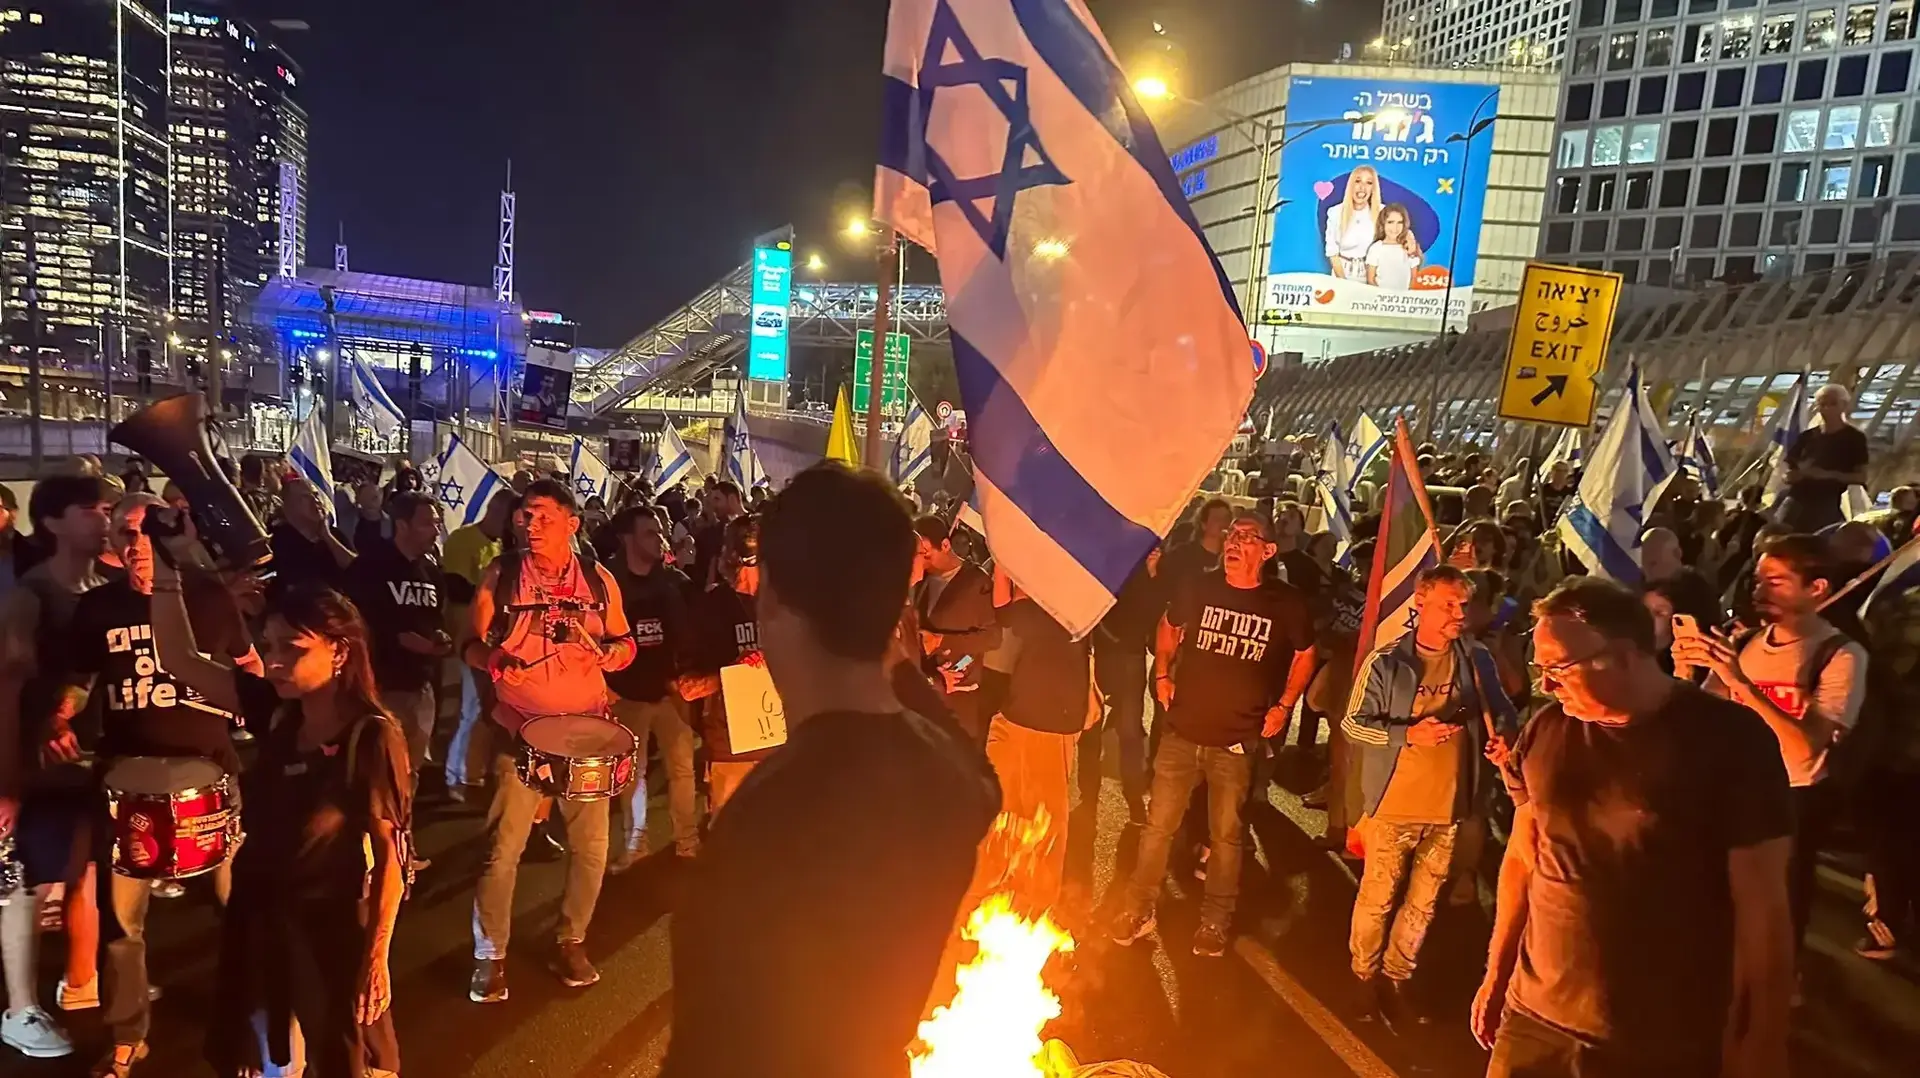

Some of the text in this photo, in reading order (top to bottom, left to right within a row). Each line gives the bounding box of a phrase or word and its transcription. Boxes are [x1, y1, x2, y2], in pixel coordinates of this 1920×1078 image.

[1377, 90, 1432, 110] בשביל
[1322, 143, 1449, 166] רק הטופ ביותר
[1272, 283, 1312, 292] מאוחדת
[1272, 292, 1311, 306] ג'וניור
[1537, 281, 1600, 304] יציאה
[1534, 311, 1589, 335] خروج
[1530, 340, 1583, 362] EXIT
[386, 581, 438, 608] VANS
[636, 622, 664, 635] FCK
[1200, 605, 1272, 642] בלעדיהם
[1196, 629, 1238, 657] הבית!
[107, 676, 177, 710] Life
